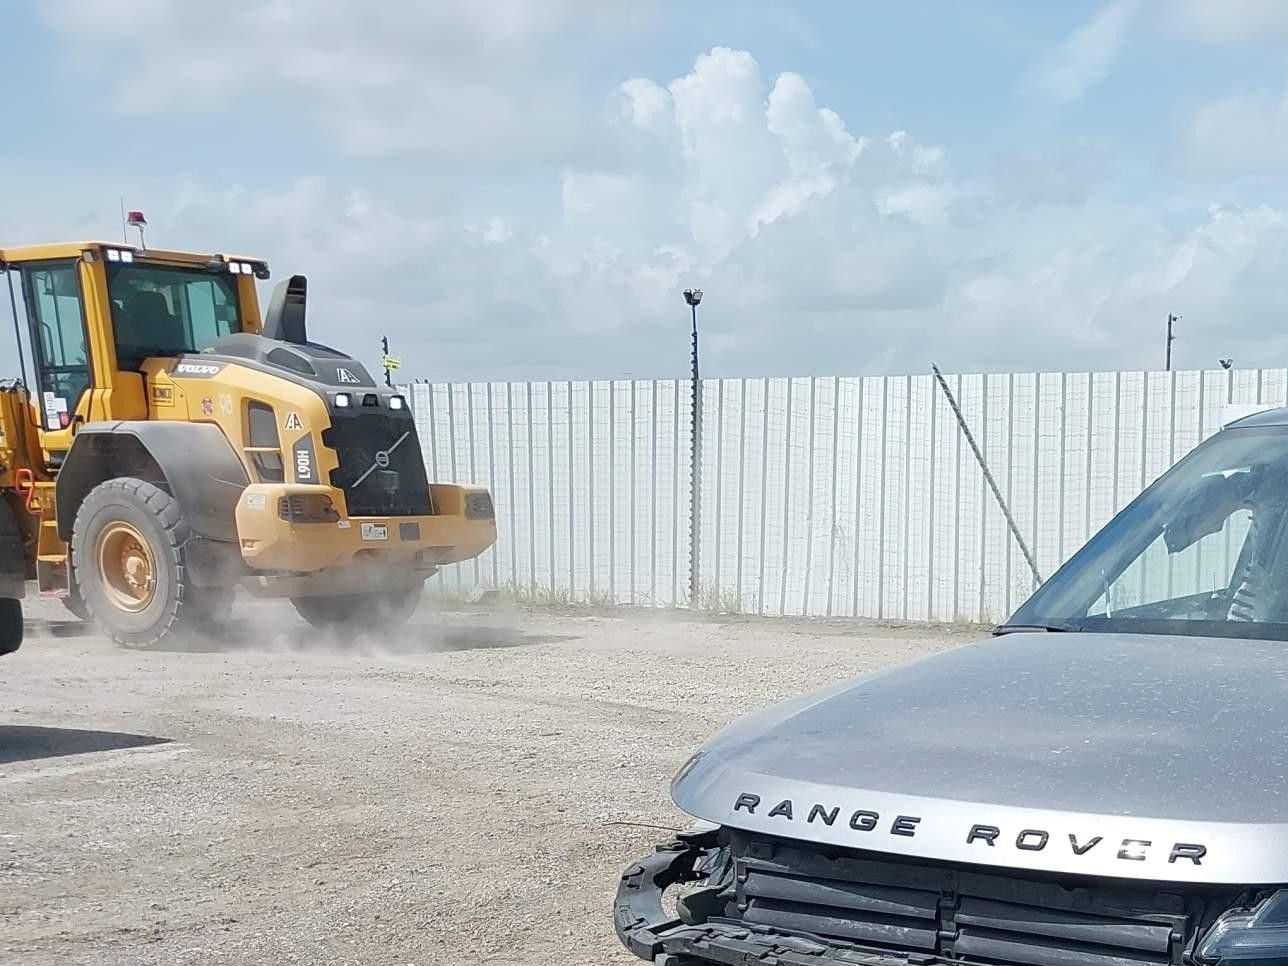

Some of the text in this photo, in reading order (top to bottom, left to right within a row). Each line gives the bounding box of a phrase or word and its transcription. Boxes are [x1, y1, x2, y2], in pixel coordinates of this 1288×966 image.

[178, 364, 219, 374] VOLVO
[296, 449, 311, 479] L90H
[734, 792, 1207, 866] RANGE ROVER
